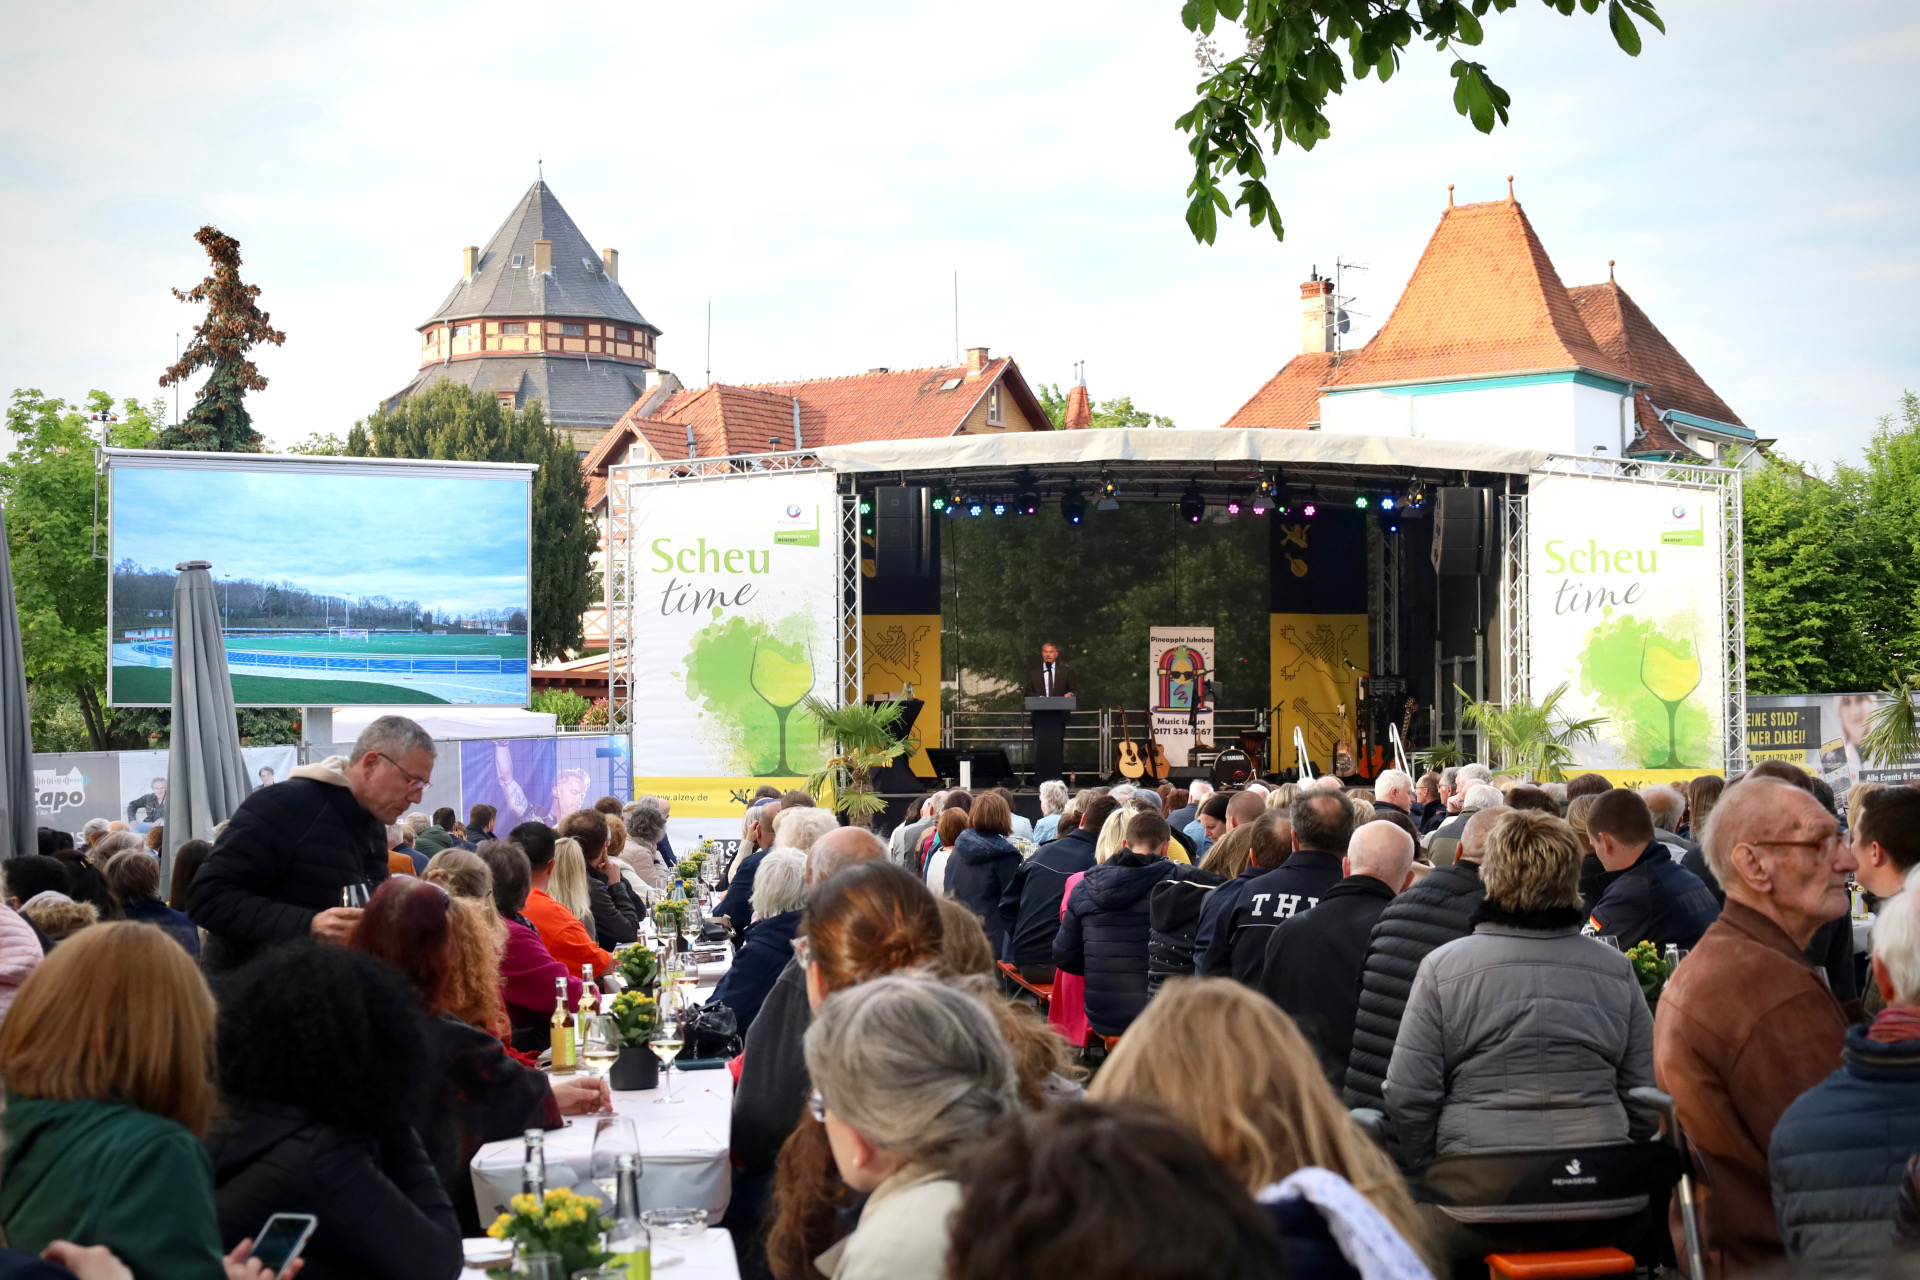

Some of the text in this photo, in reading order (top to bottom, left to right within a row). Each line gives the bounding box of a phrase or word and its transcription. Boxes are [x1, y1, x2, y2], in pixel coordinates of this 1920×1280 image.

[651, 537, 769, 574] Scheu
[1545, 539, 1656, 574] Scheu
[660, 577, 759, 616] time
[1555, 578, 1647, 615] time
[1150, 636, 1214, 644] Pineapple Jukebox
[1157, 717, 1180, 725] Music
[1181, 717, 1188, 725] is
[1746, 712, 1767, 727] EINE
[1770, 711, 1798, 727] STADT
[1153, 727, 1171, 735] 0171
[1173, 727, 1188, 735] 534
[1774, 730, 1806, 745] DABEI!
[1866, 774, 1879, 782] Alle
[1880, 773, 1902, 782] Events
[1251, 893, 1319, 919] TH
